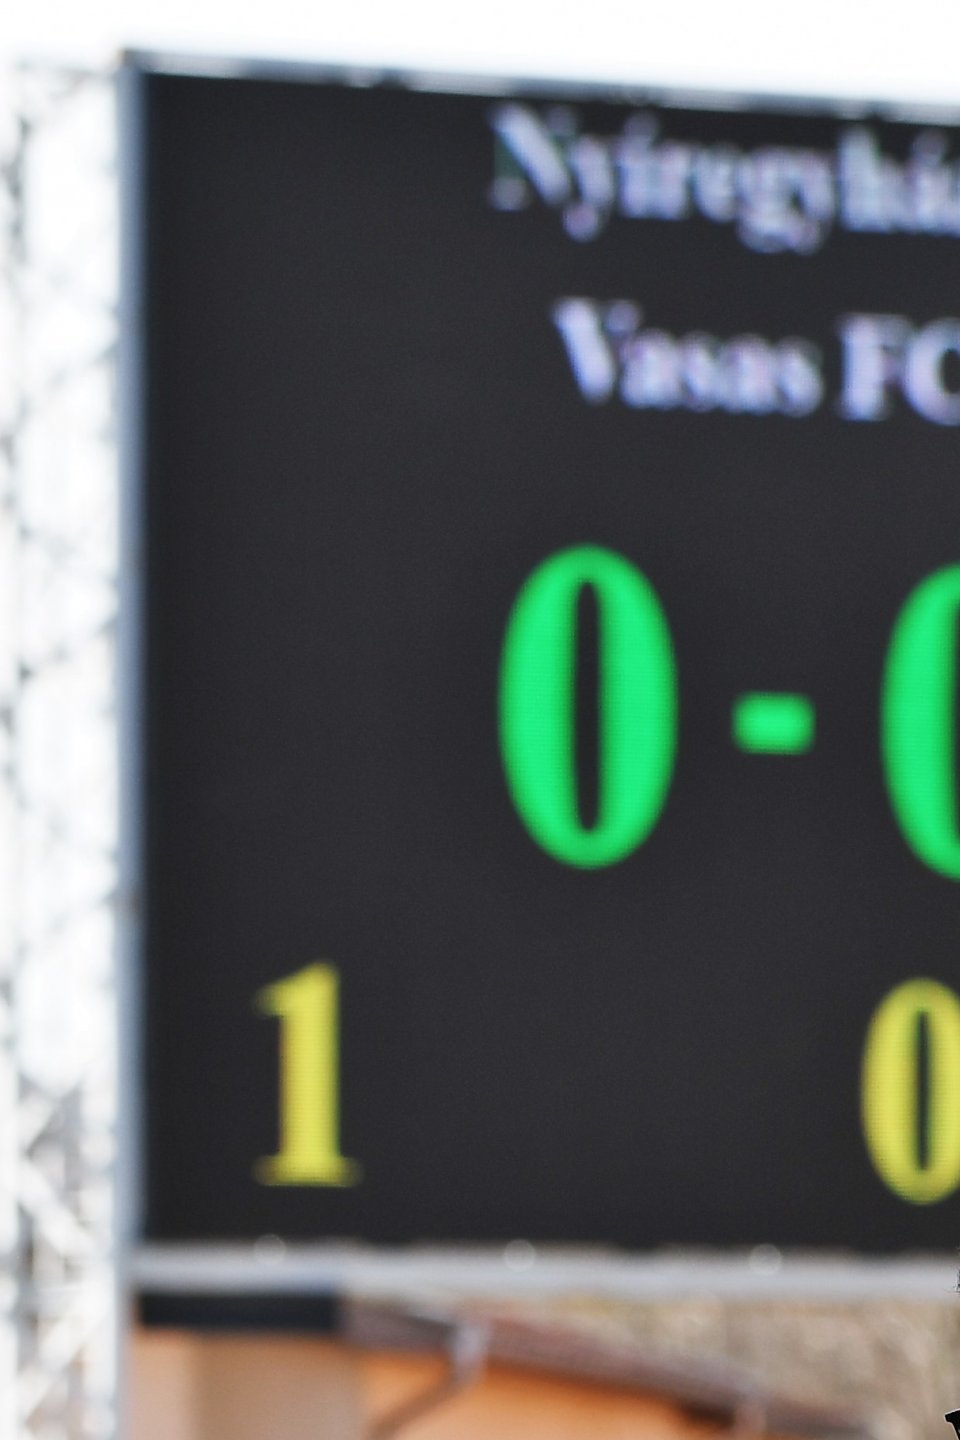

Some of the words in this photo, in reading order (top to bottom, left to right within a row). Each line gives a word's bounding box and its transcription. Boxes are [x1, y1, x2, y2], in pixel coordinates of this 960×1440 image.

[553, 298, 824, 417] Vasas
[499, 546, 678, 869] 0
[257, 963, 358, 1187] 1
